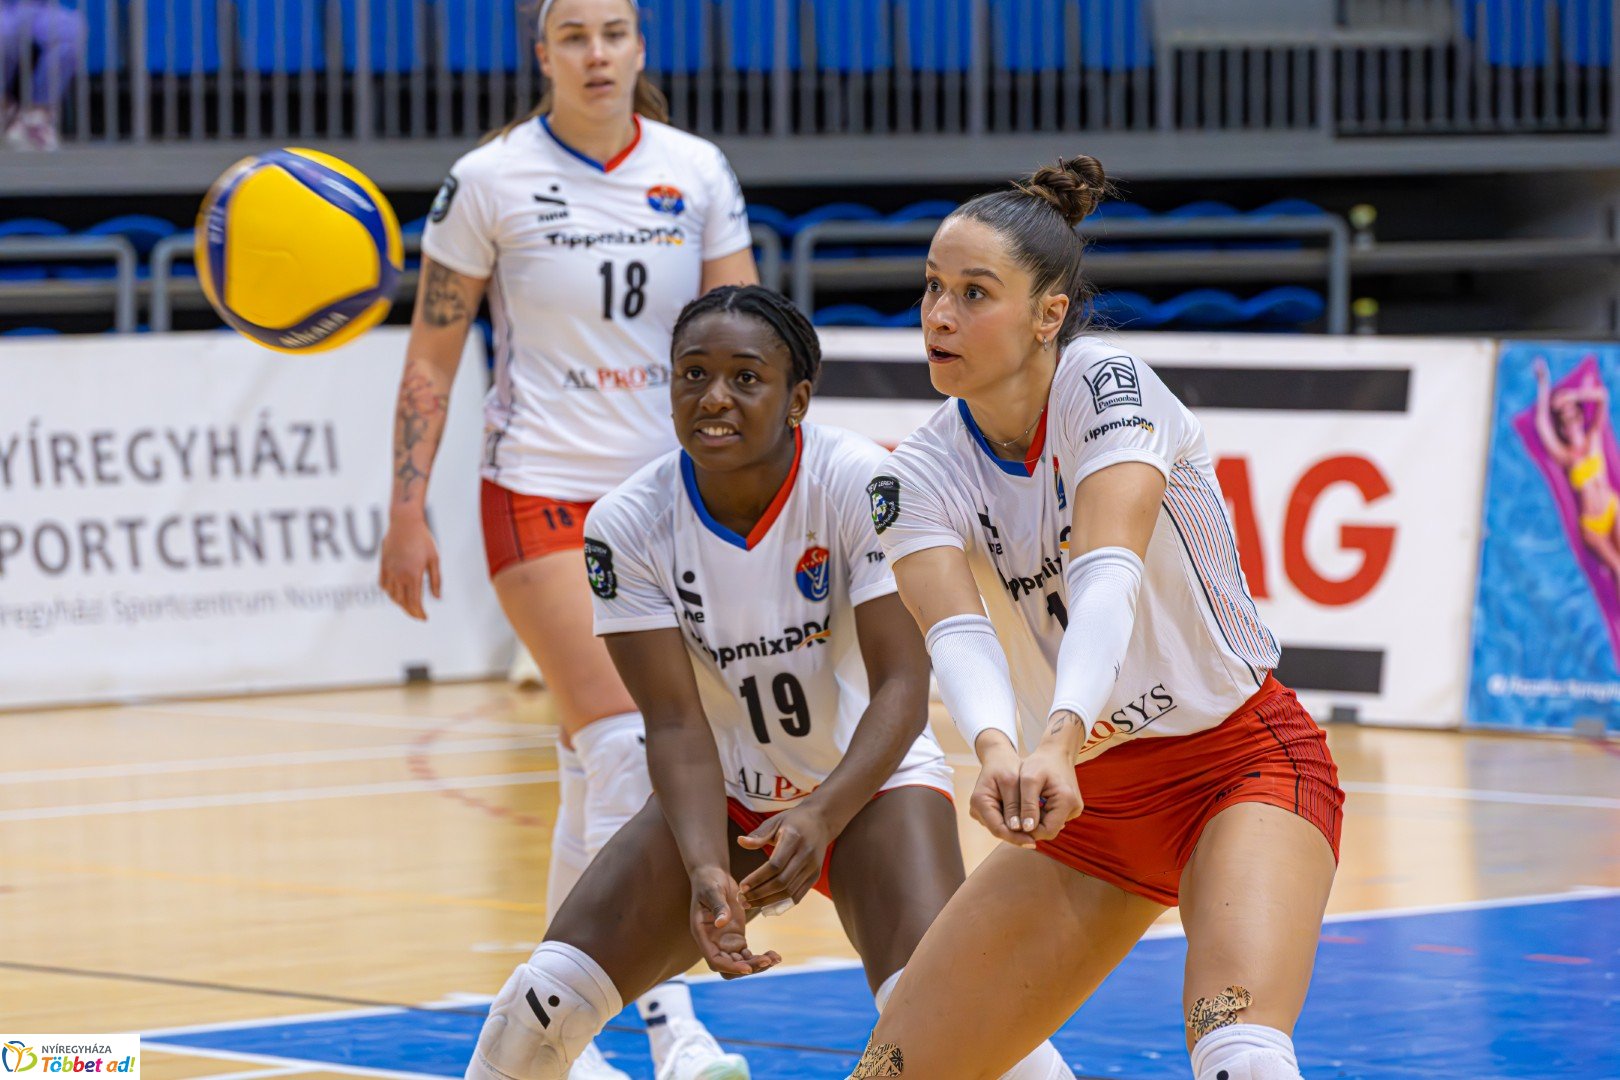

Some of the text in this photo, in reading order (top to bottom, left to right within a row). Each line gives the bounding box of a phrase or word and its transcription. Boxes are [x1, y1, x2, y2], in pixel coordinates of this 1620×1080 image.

[599, 261, 648, 320] 18
[0, 503, 436, 578] PORTCENTRU
[739, 672, 811, 744] 19
